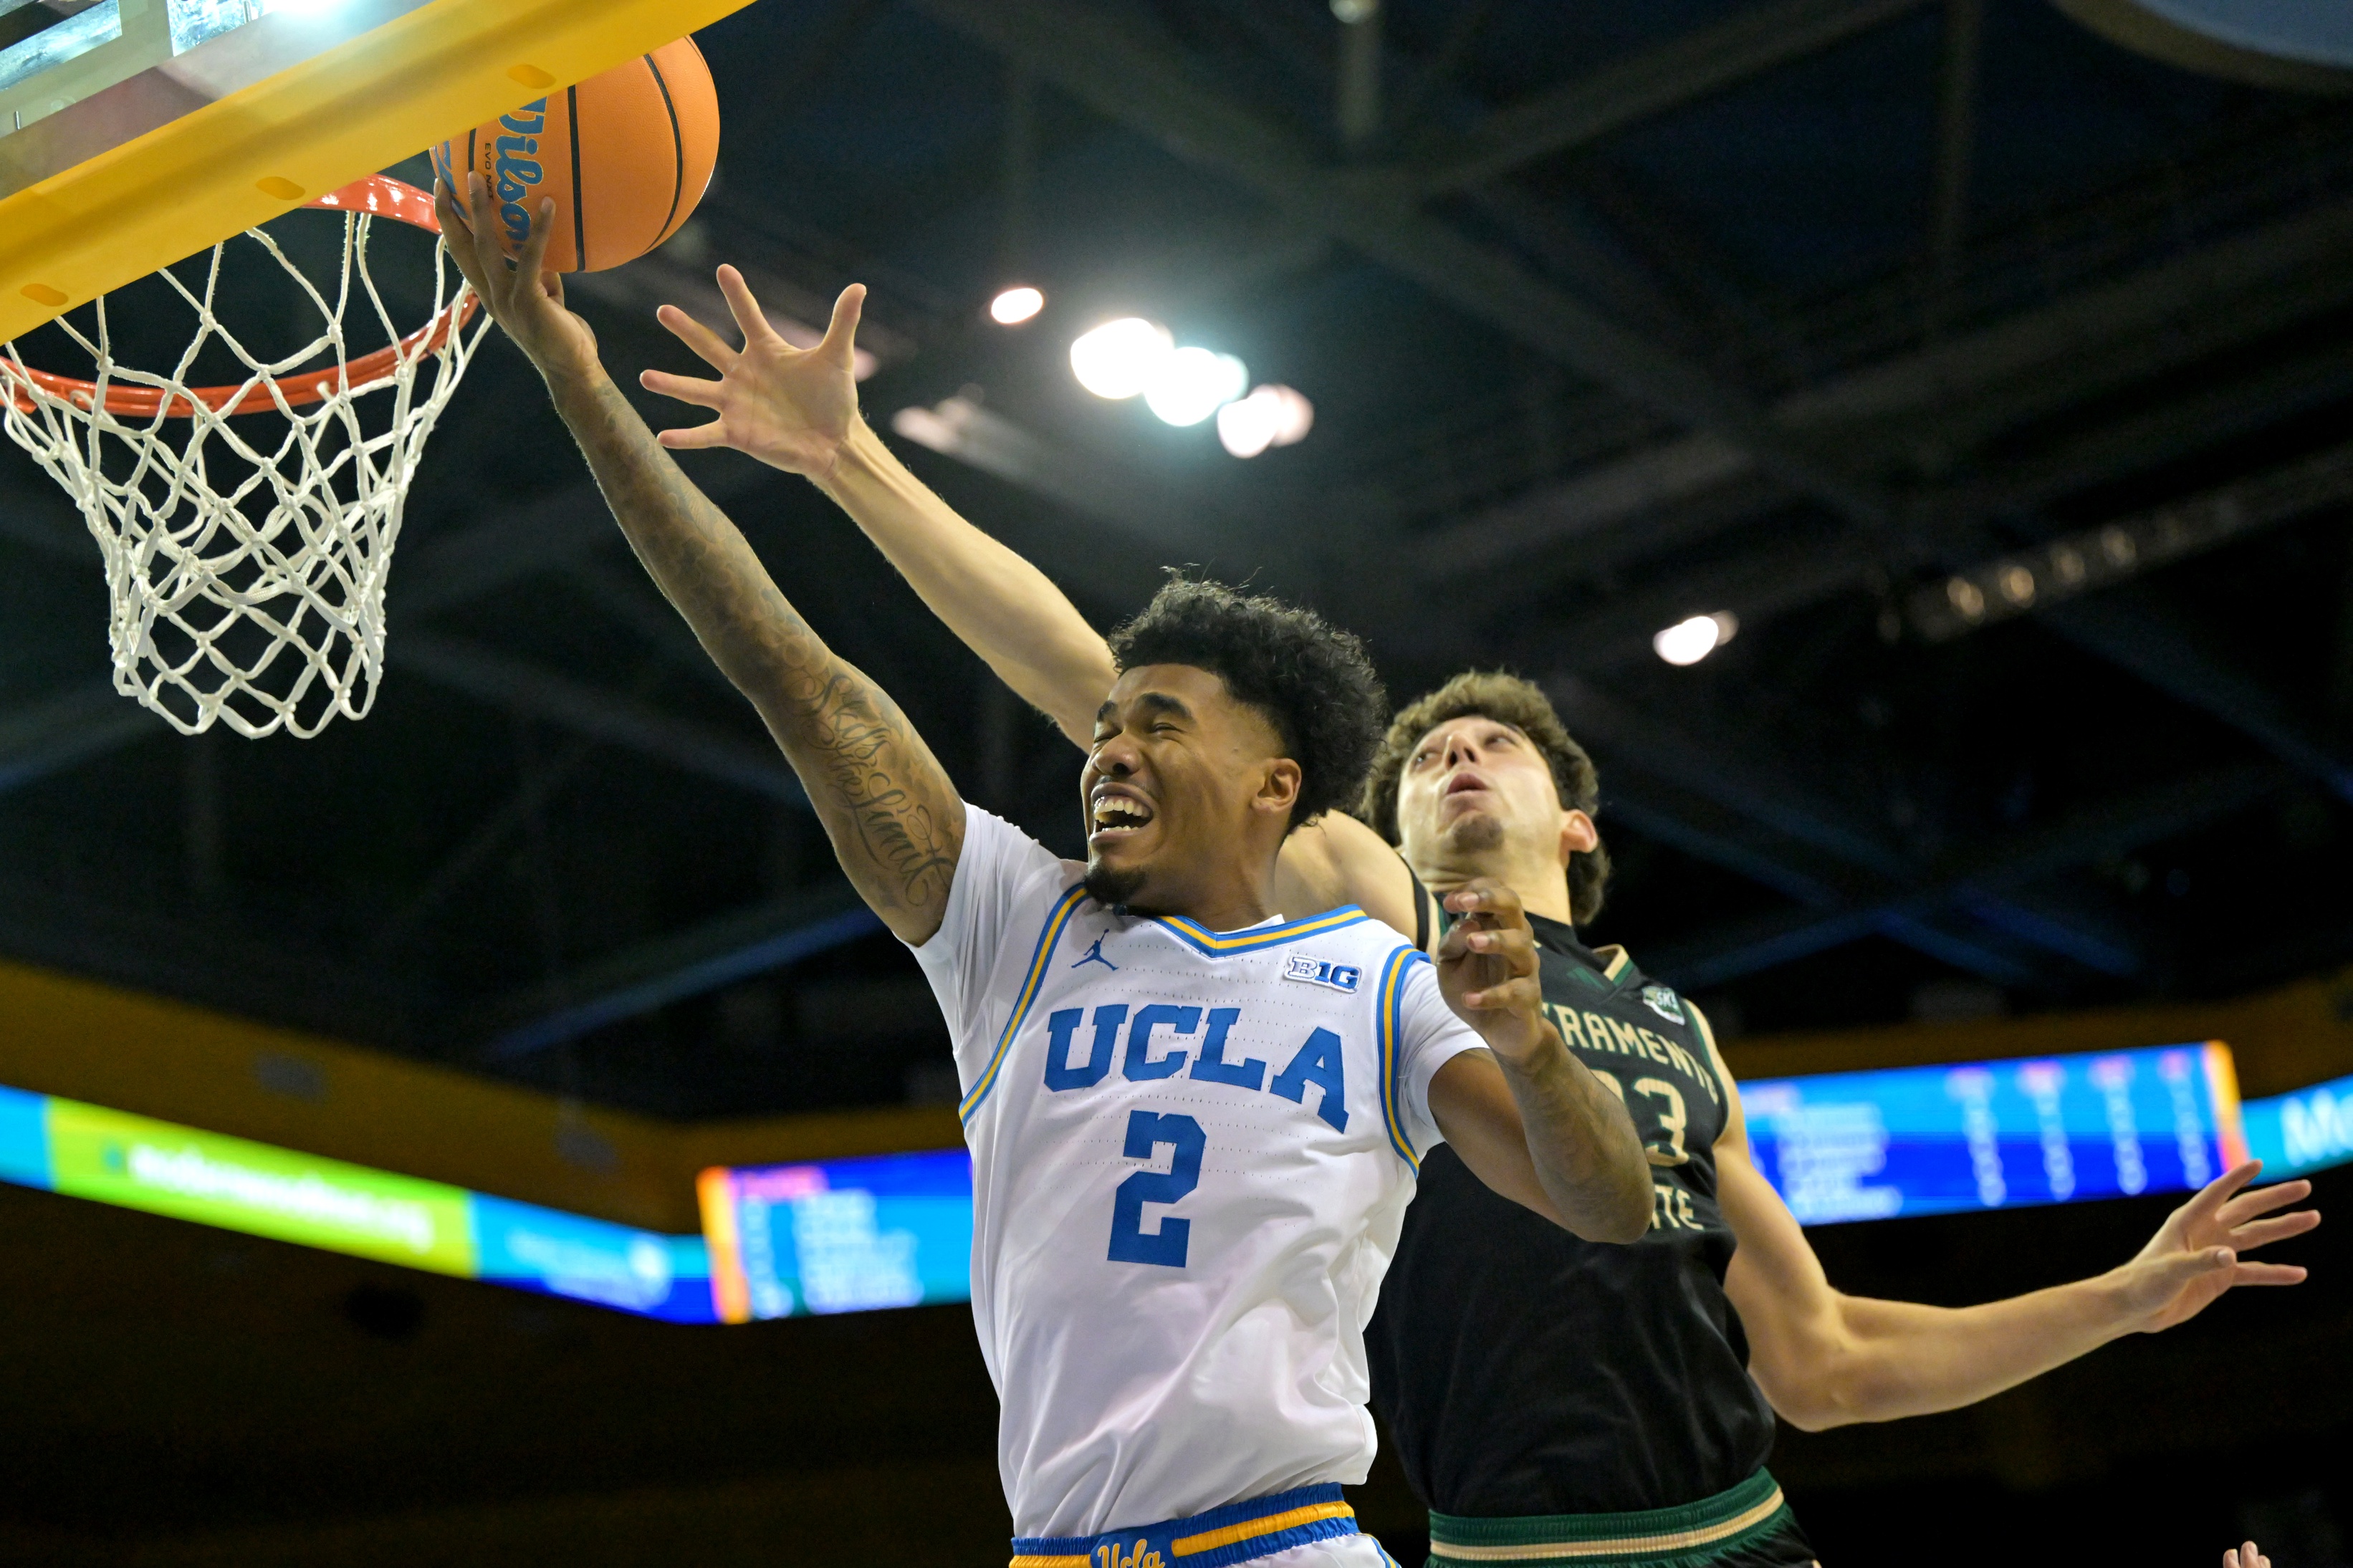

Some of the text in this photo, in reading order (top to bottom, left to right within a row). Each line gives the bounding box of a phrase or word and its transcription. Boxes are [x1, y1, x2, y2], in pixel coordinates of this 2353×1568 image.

[1043, 1004, 1350, 1134] UCLA
[1107, 1110, 1207, 1268] 2
[1652, 1184, 1705, 1231] TE
